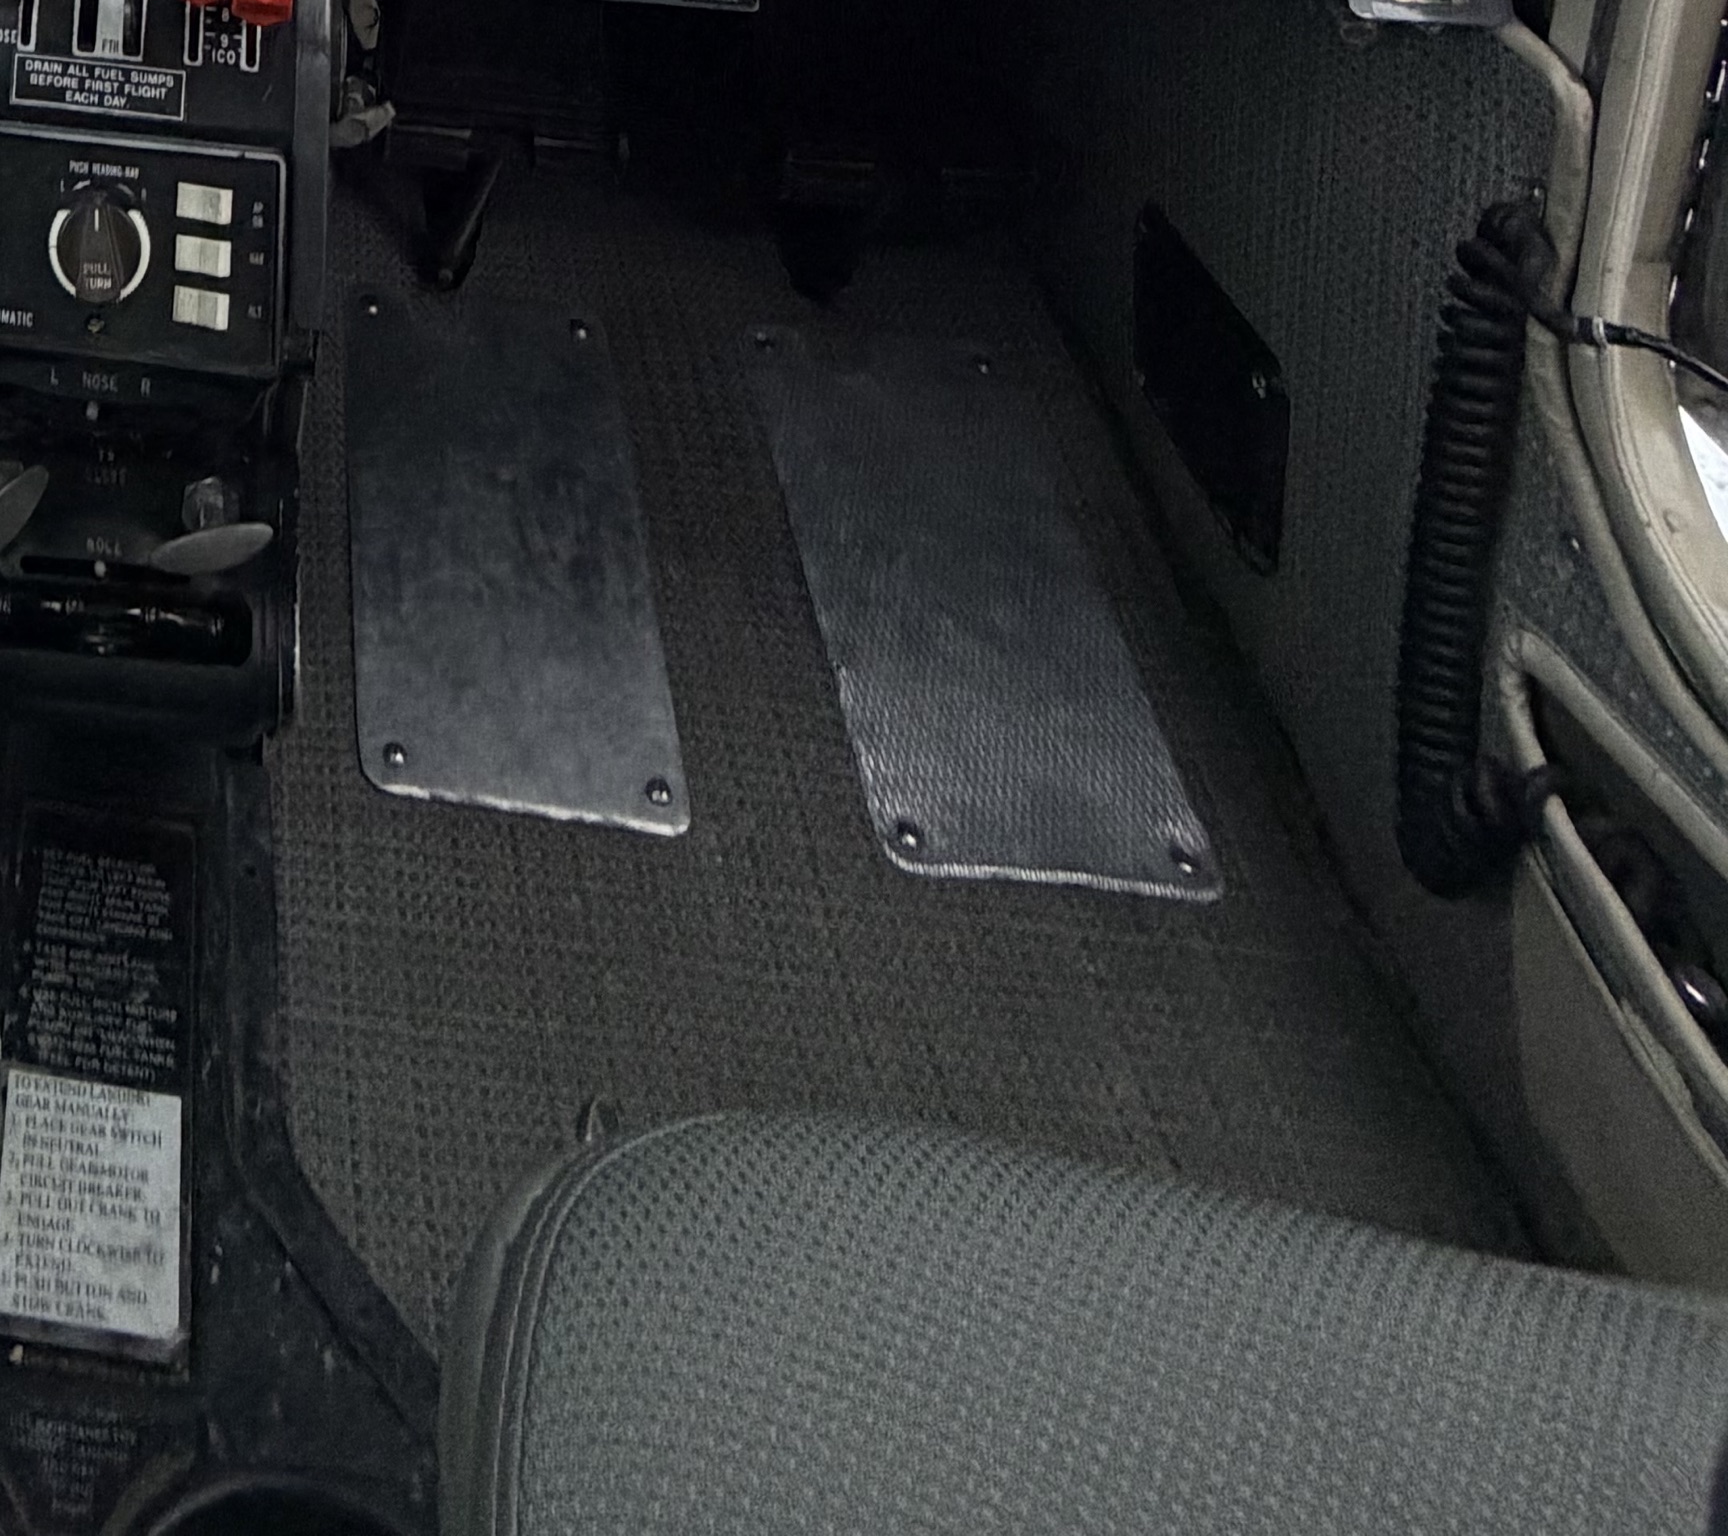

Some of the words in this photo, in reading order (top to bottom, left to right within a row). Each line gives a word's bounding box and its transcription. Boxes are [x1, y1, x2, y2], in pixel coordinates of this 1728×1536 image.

[25, 61, 64, 75] DRAIN
[68, 64, 89, 77] ALL
[94, 67, 125, 82] FUEL
[130, 71, 174, 86] SUMPS
[29, 73, 81, 88] BEFORE
[84, 78, 119, 93] FIRST
[124, 83, 169, 101] FLIGHT
[65, 90, 99, 105] EACH
[83, 276, 113, 290] TURN
[82, 373, 119, 392] NOSE
